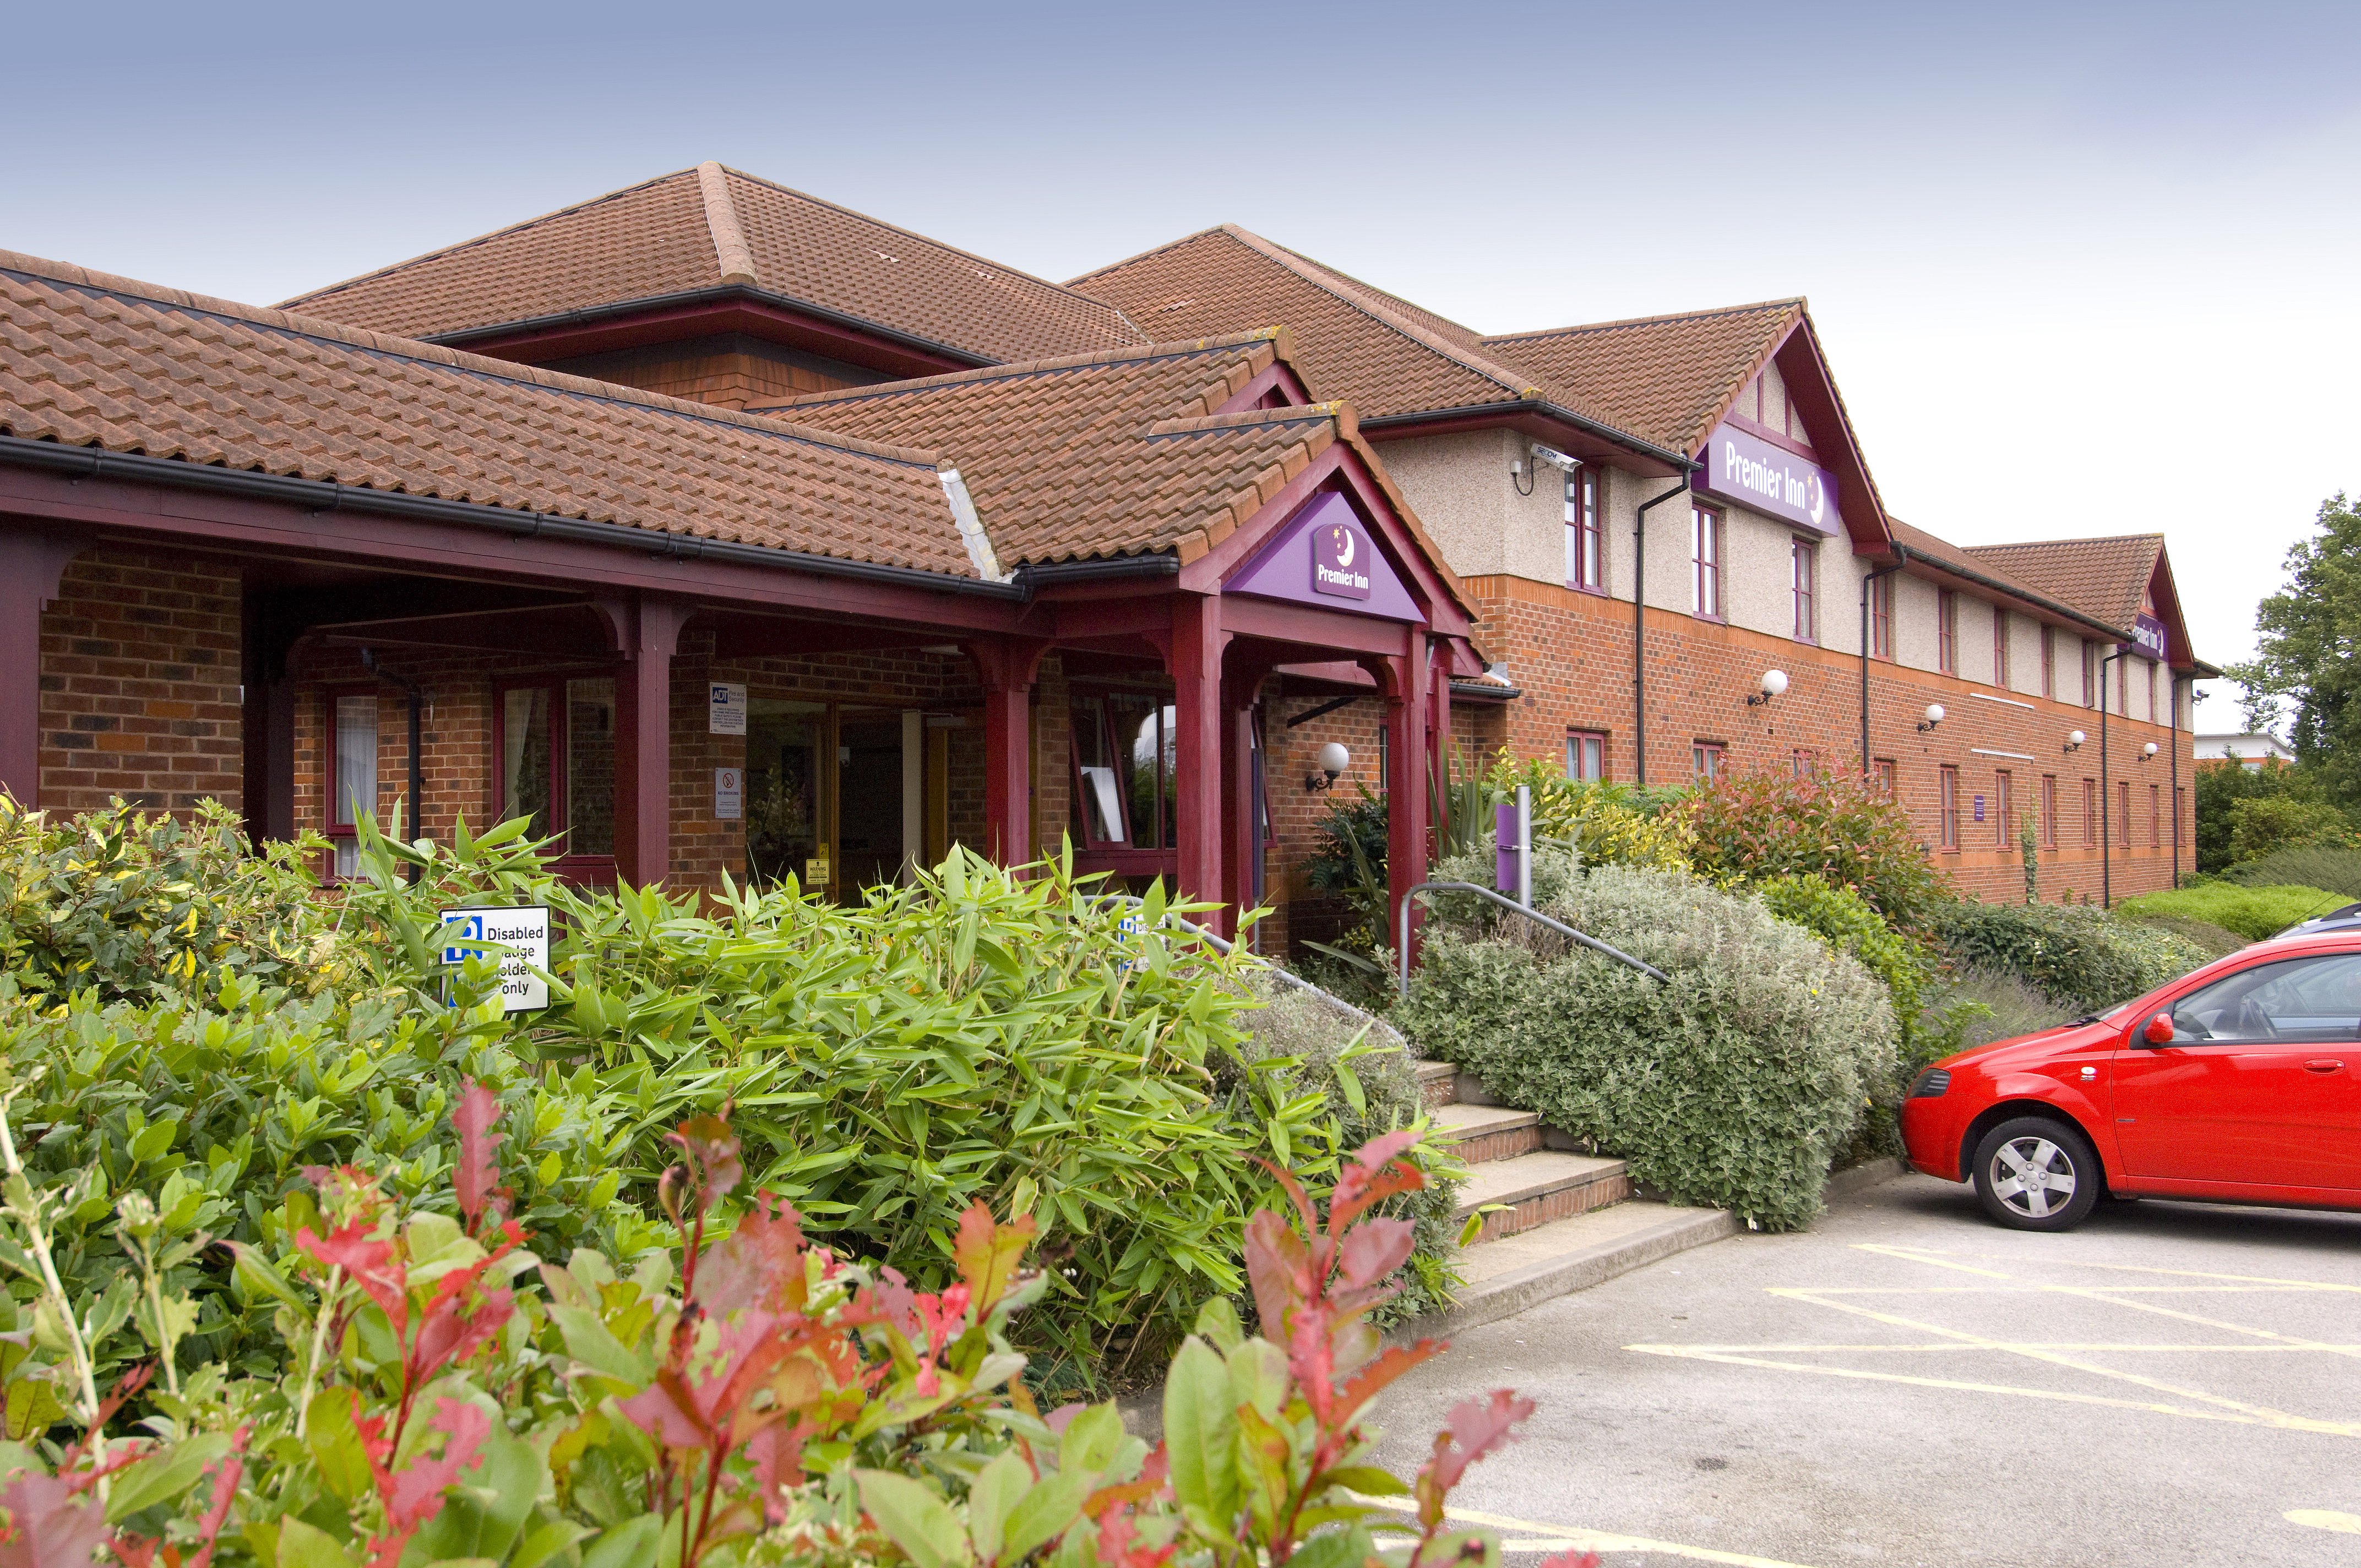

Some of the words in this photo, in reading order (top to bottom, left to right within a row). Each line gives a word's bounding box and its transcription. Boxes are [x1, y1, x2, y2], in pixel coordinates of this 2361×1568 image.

[1537, 447, 1557, 459] SECOM
[1726, 441, 1782, 499] Premier
[1785, 467, 1805, 509] Inn
[1318, 564, 1354, 586] Premier
[1354, 571, 1368, 589] Inn
[713, 690, 728, 701] ADT
[488, 925, 543, 941] Disabled
[1138, 922, 1163, 932] Dised
[501, 945, 535, 960] adge
[494, 963, 539, 977] olde
[502, 981, 529, 995] only
